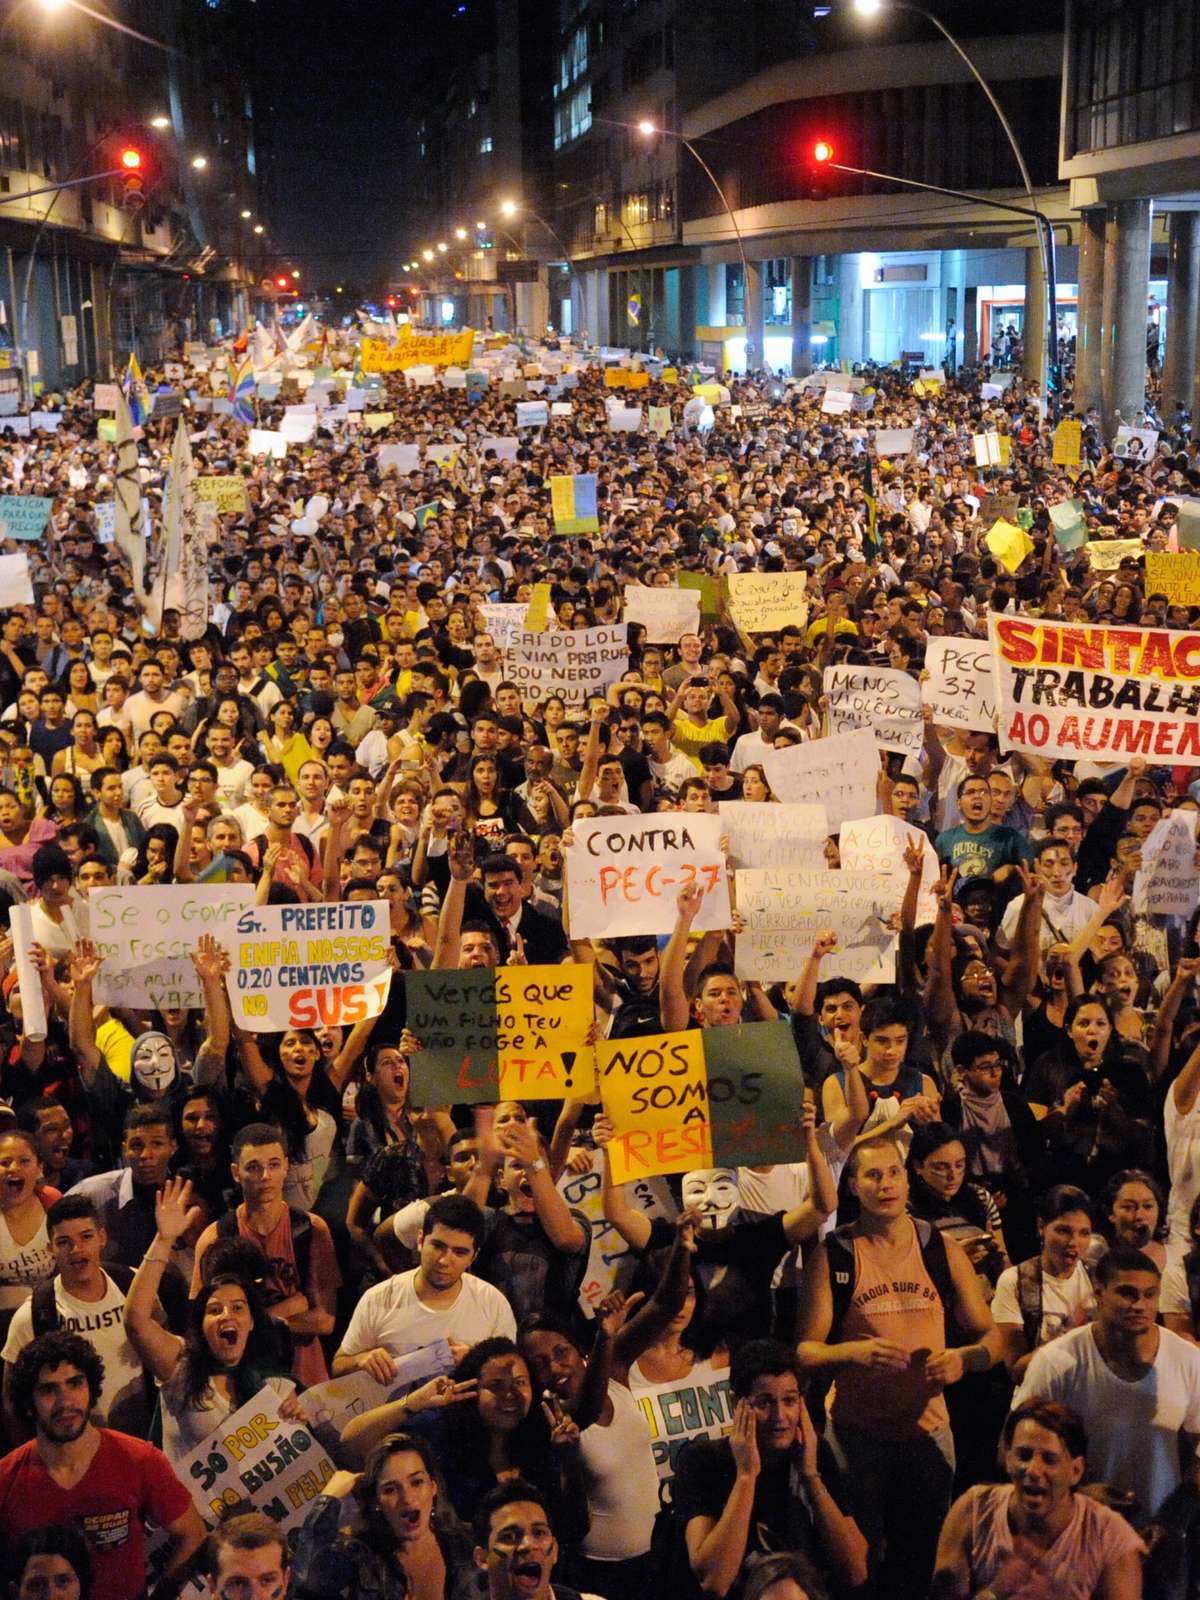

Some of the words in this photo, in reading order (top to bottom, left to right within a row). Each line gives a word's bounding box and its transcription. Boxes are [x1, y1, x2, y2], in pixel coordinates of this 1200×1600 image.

[551, 634, 576, 648] DO
[585, 630, 623, 648] LOL
[505, 647, 517, 662] E
[521, 650, 559, 664] VIM
[567, 650, 598, 665] PRA
[600, 647, 629, 663] RUA
[941, 648, 991, 675] PEC
[507, 664, 543, 680] SOU
[551, 667, 602, 681] NERD
[831, 671, 900, 699] MENOS
[517, 682, 542, 700] ÃO
[545, 686, 579, 701] SOU
[937, 676, 976, 701] 37
[830, 691, 923, 719] VIOLÊNCIA
[1008, 710, 1050, 747] AO
[586, 826, 696, 856] CONTRA
[952, 841, 994, 860] HURLEY
[95, 893, 140, 929] Se
[237, 911, 267, 934] Sr.
[306, 935, 386, 965] NOSSOS
[277, 962, 365, 987] CENTAVOS
[242, 993, 269, 1017] NO
[415, 1014, 449, 1029] UM
[523, 1013, 562, 1030] TEU
[603, 1040, 690, 1079] NÓS
[631, 1072, 764, 1115] SOMOS
[682, 1105, 706, 1126] A
[892, 1281, 921, 1294] SURF
[60, 1304, 125, 1333] OLLIST
[190, 1440, 229, 1493] SÓ
[222, 1412, 281, 1463] POR
[239, 1429, 312, 1495] BUSÃO
[284, 1457, 336, 1511] PELA
